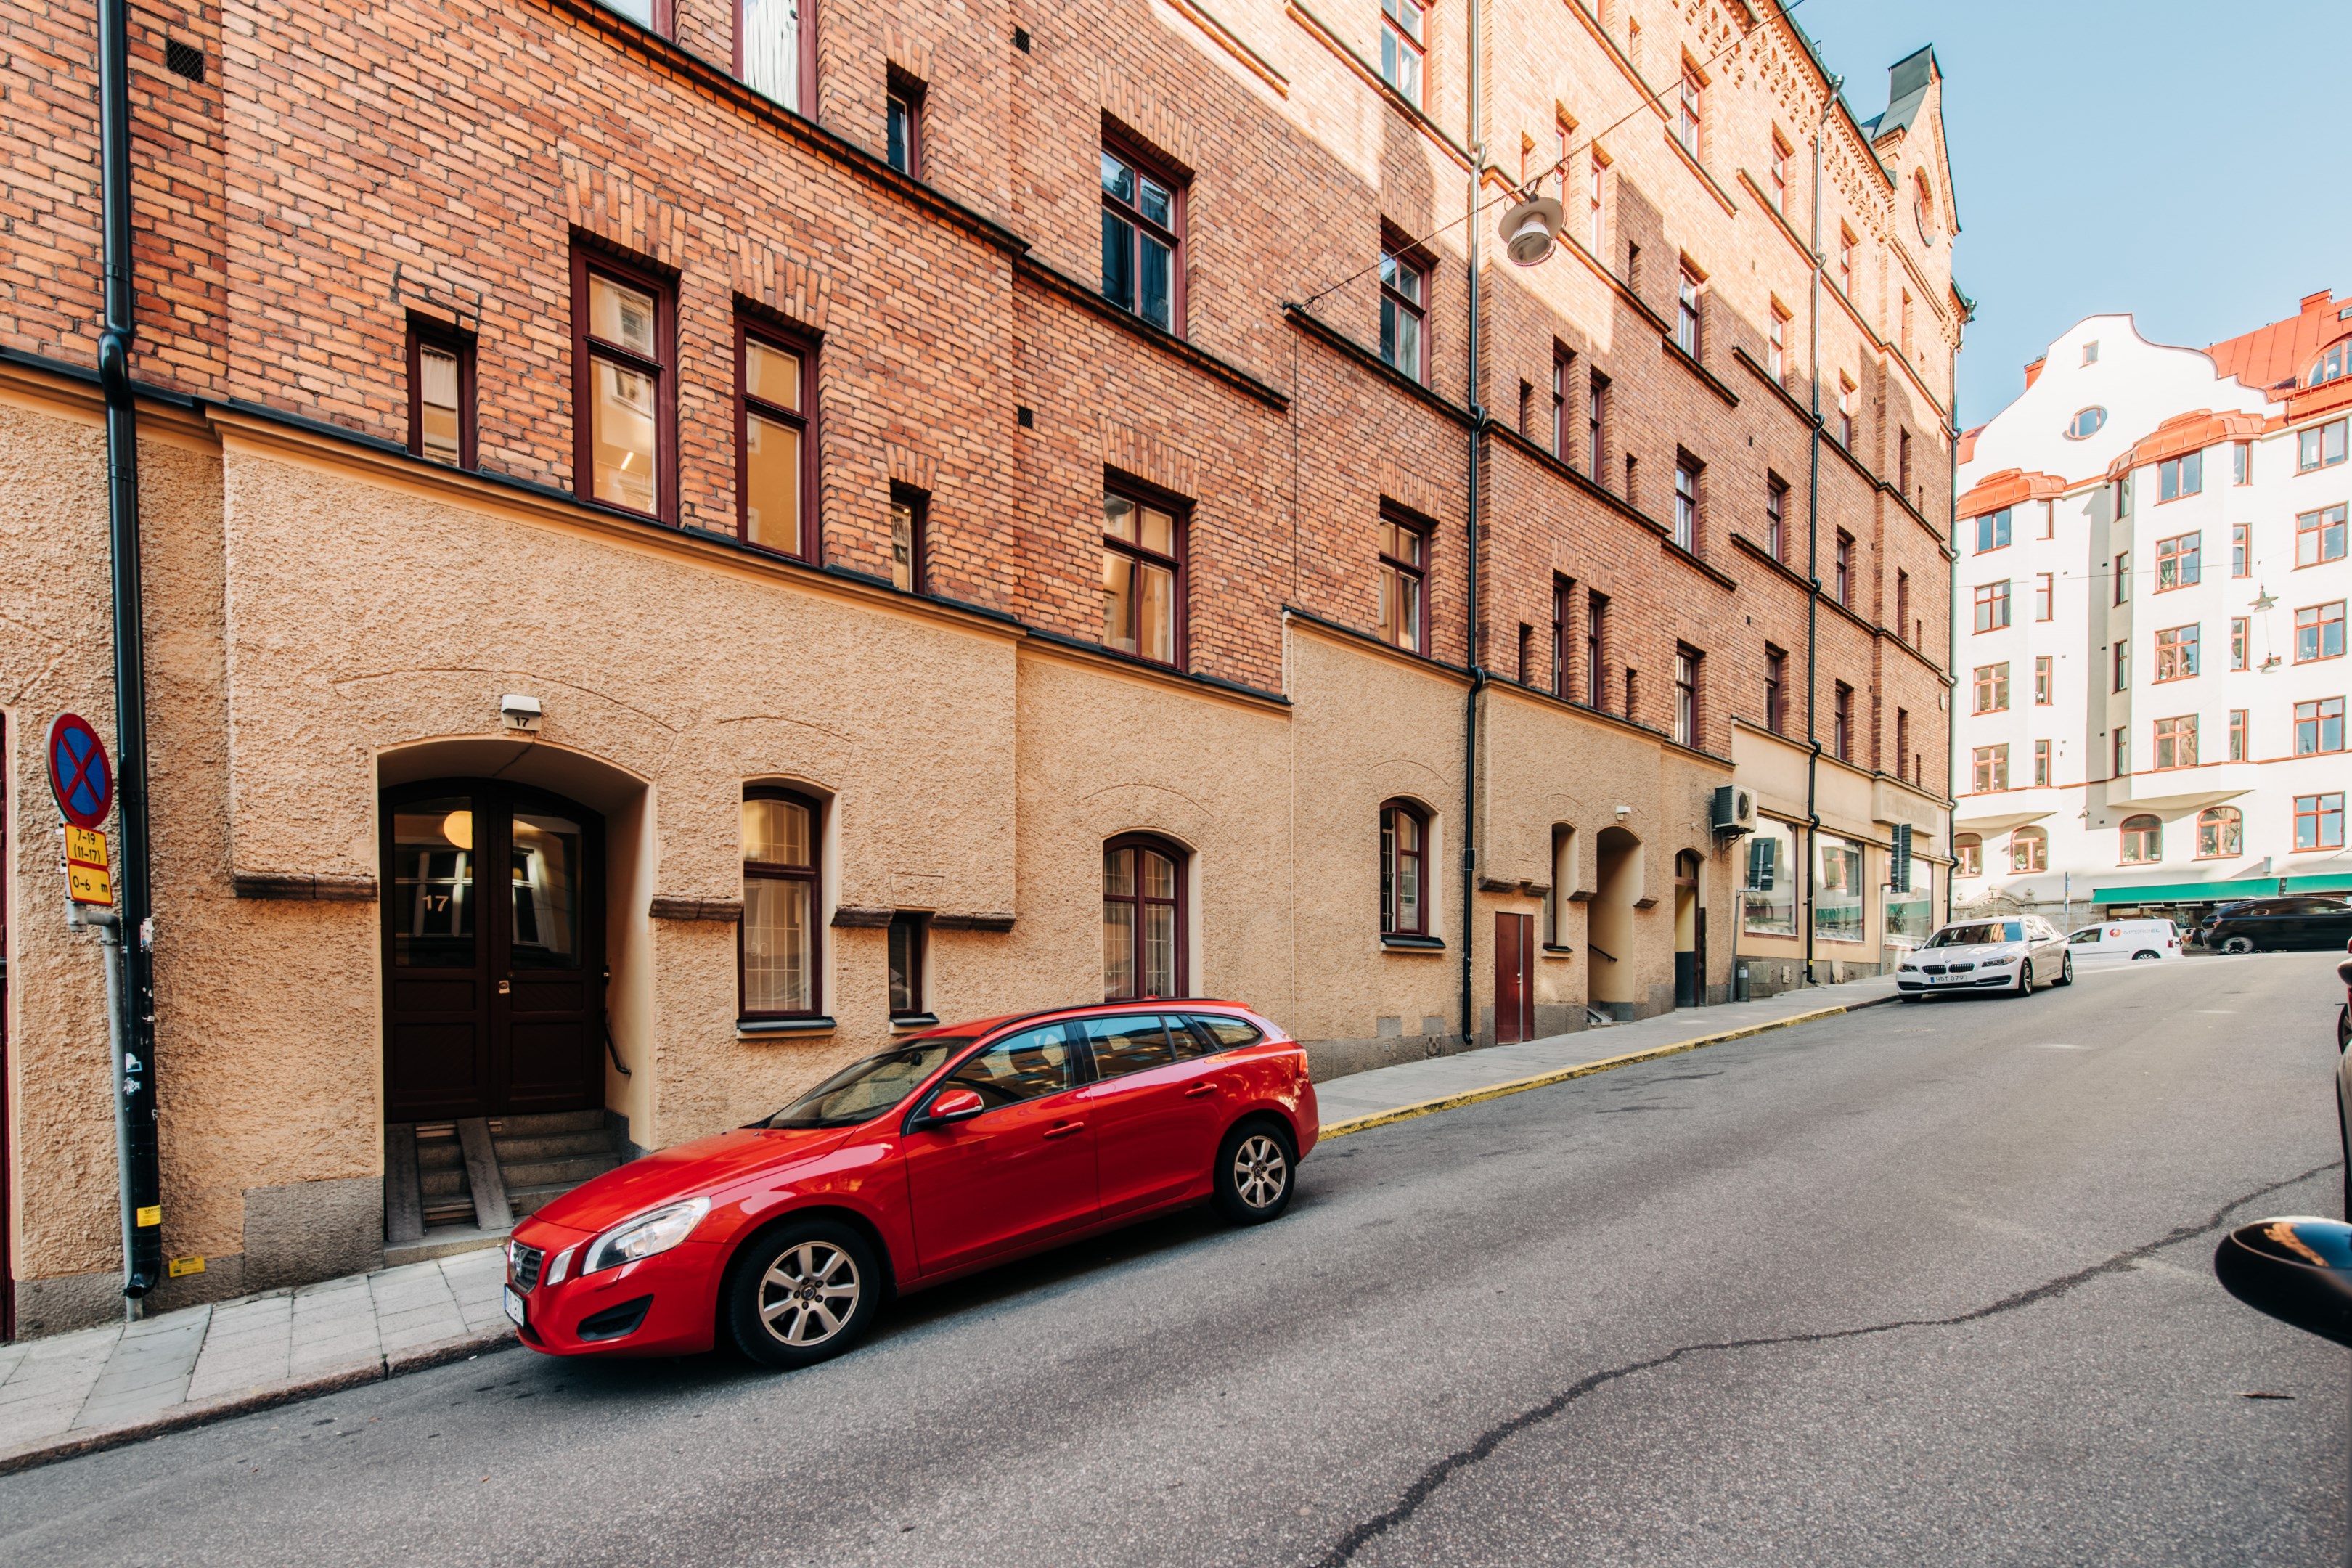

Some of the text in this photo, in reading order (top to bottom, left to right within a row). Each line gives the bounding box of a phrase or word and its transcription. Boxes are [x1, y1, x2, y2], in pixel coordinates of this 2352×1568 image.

[513, 716, 530, 727] 17
[75, 828, 96, 846] 7-19
[73, 844, 101, 864] (11-17)
[72, 875, 108, 894] 0-6 m
[422, 894, 449, 912] 17
